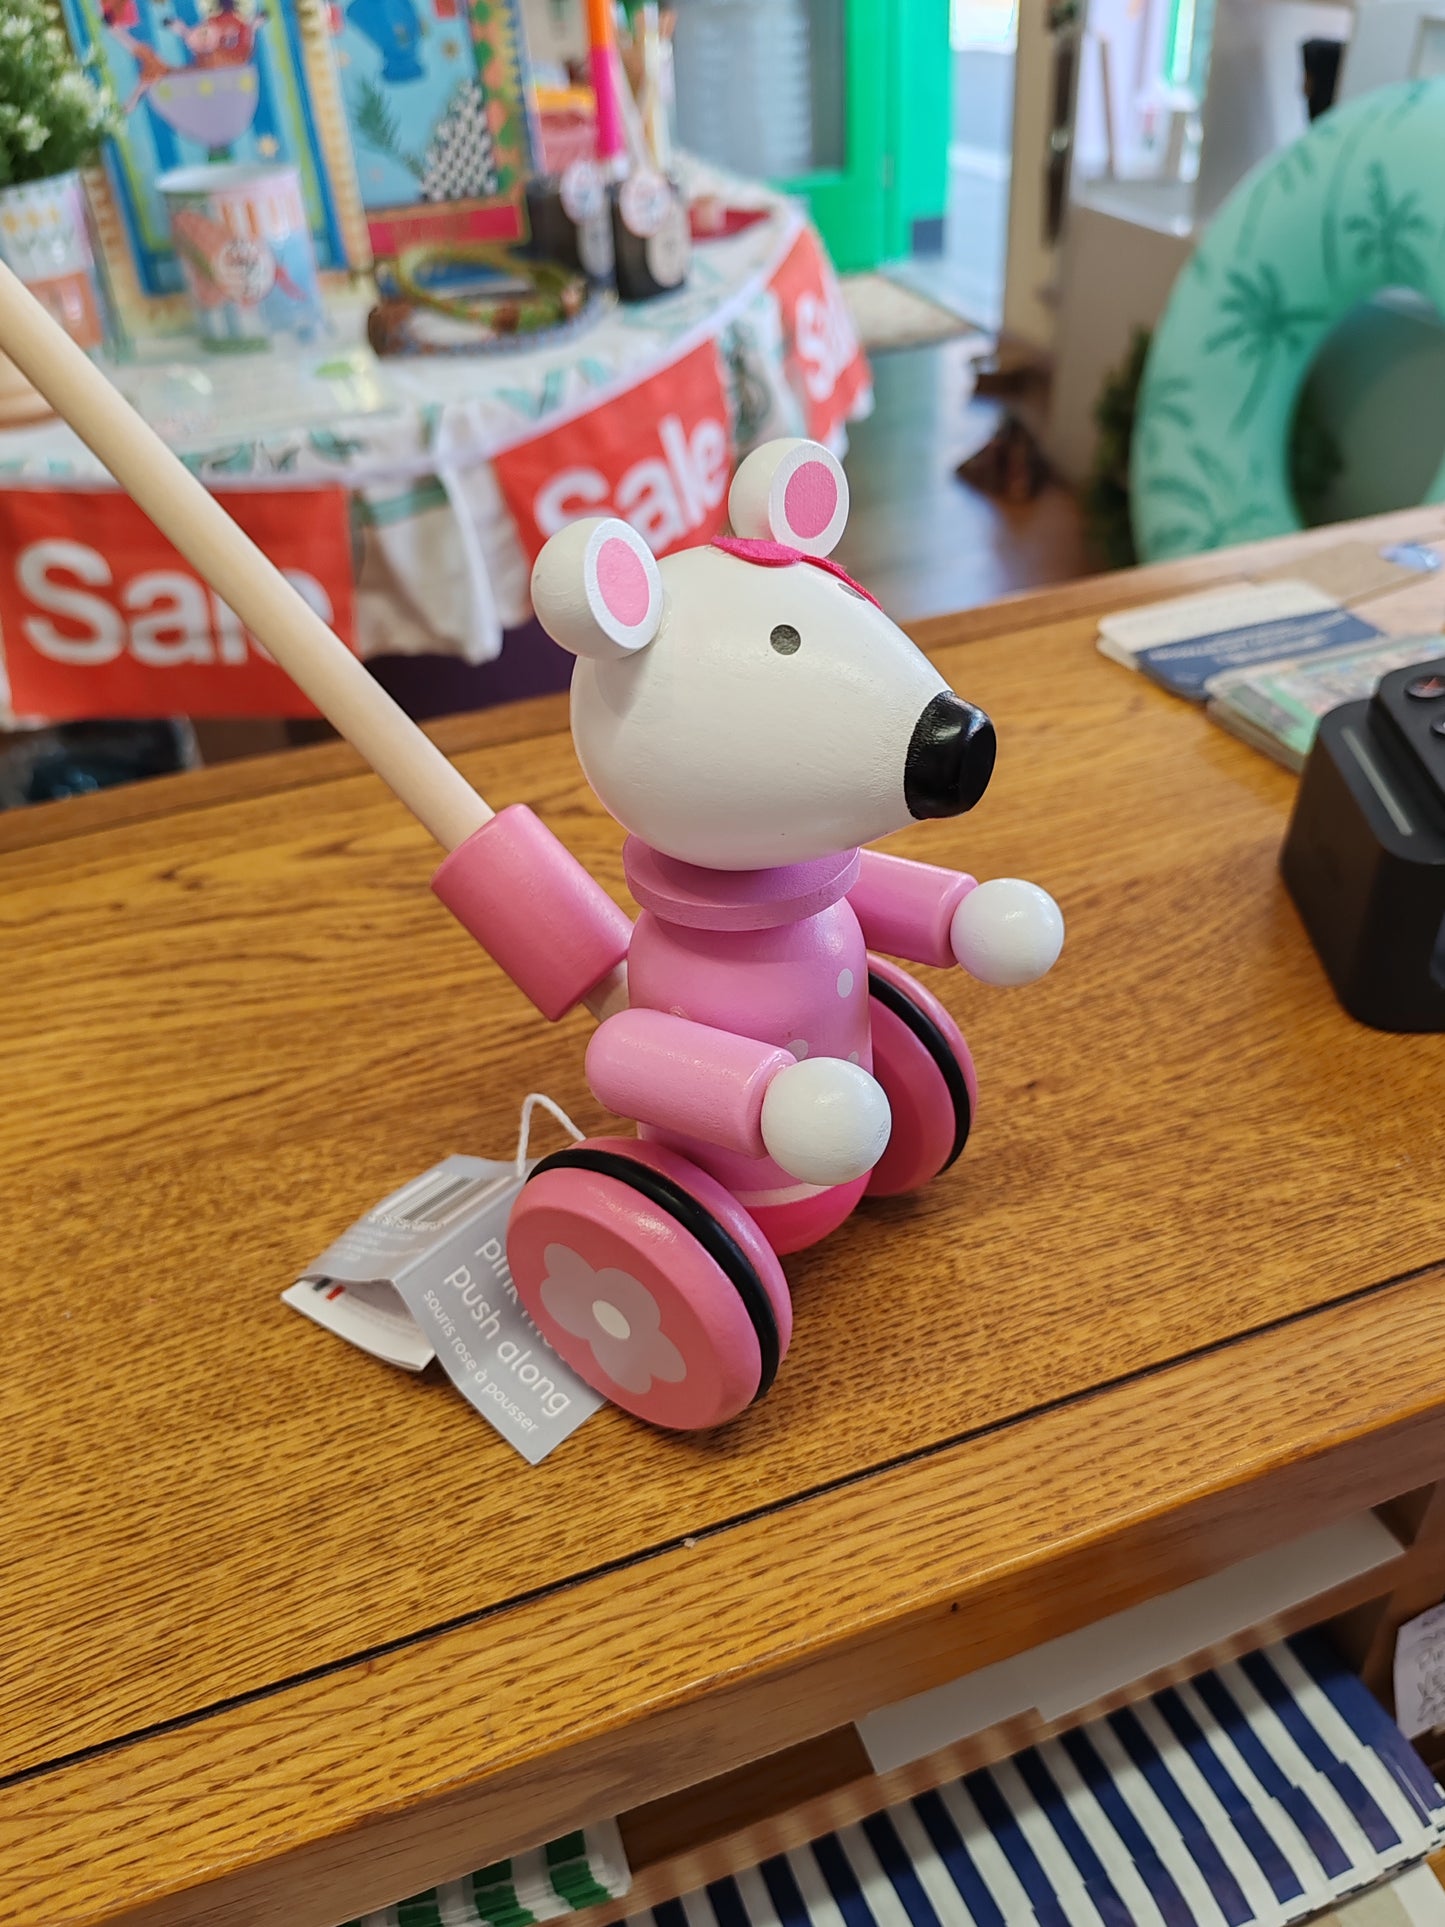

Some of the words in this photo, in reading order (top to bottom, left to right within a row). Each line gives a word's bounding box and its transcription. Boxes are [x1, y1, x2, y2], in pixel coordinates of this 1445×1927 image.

[423, 1289, 457, 1337] souris
[451, 1336, 478, 1371] rose
[482, 1381, 540, 1433] pousser
[443, 1264, 501, 1340] push
[497, 1340, 571, 1417] along
